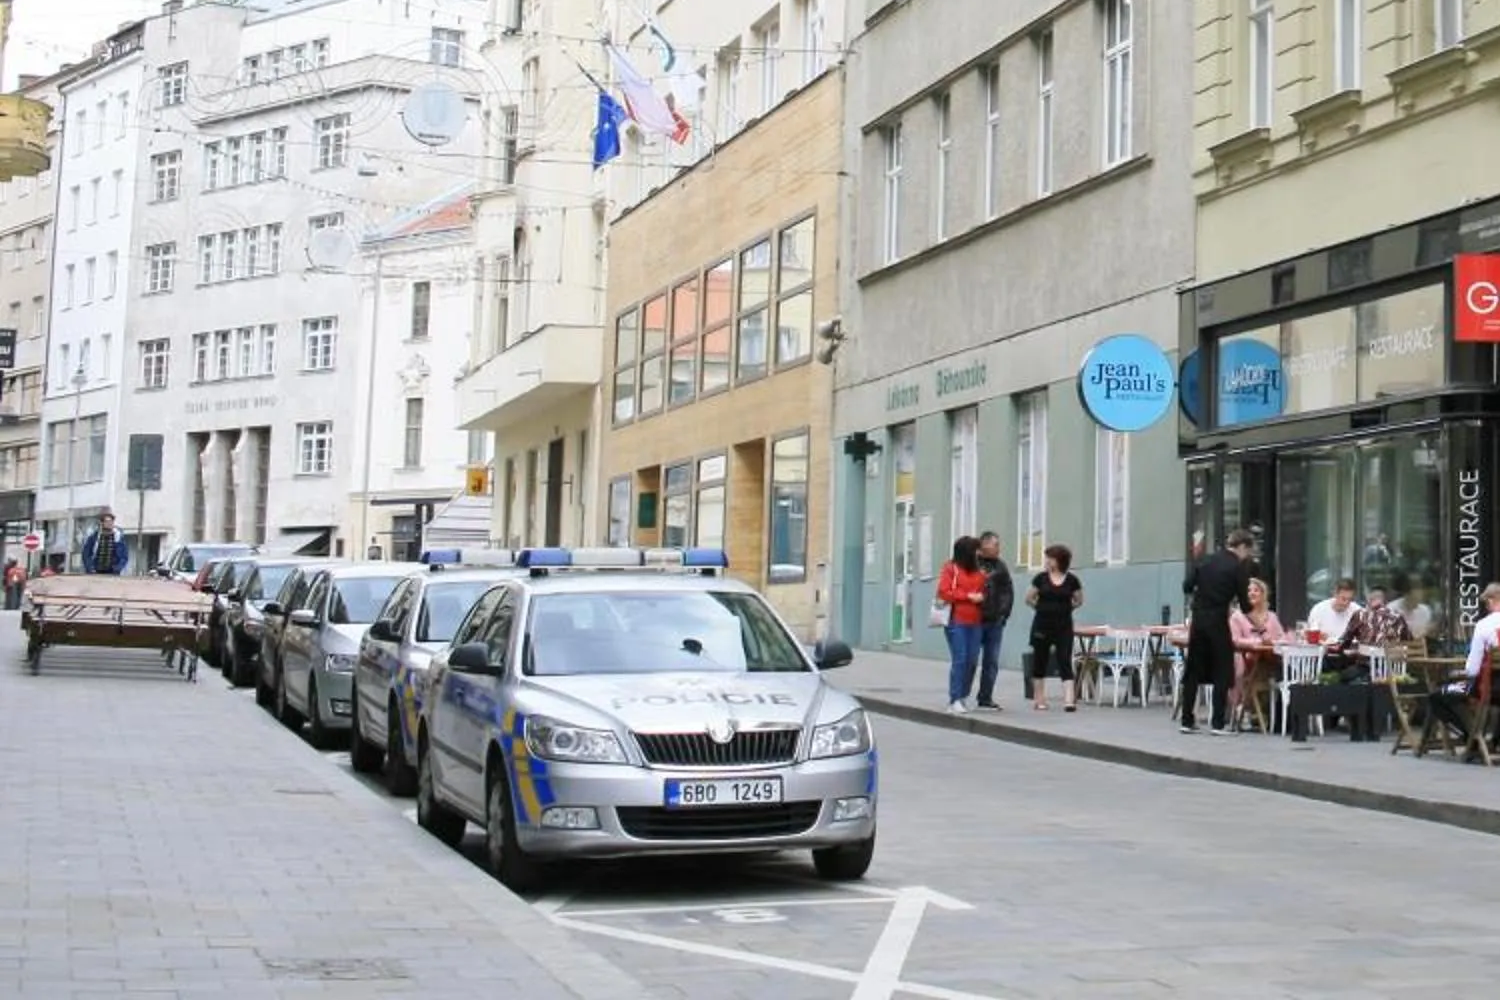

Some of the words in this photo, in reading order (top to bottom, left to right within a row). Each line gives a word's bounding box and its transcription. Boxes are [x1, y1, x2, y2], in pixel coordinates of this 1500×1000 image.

[1090, 362, 1140, 385] Jean
[1459, 468, 1481, 627] RESTAURACE
[682, 784, 717, 803] 6B0
[732, 782, 773, 801] 1249
